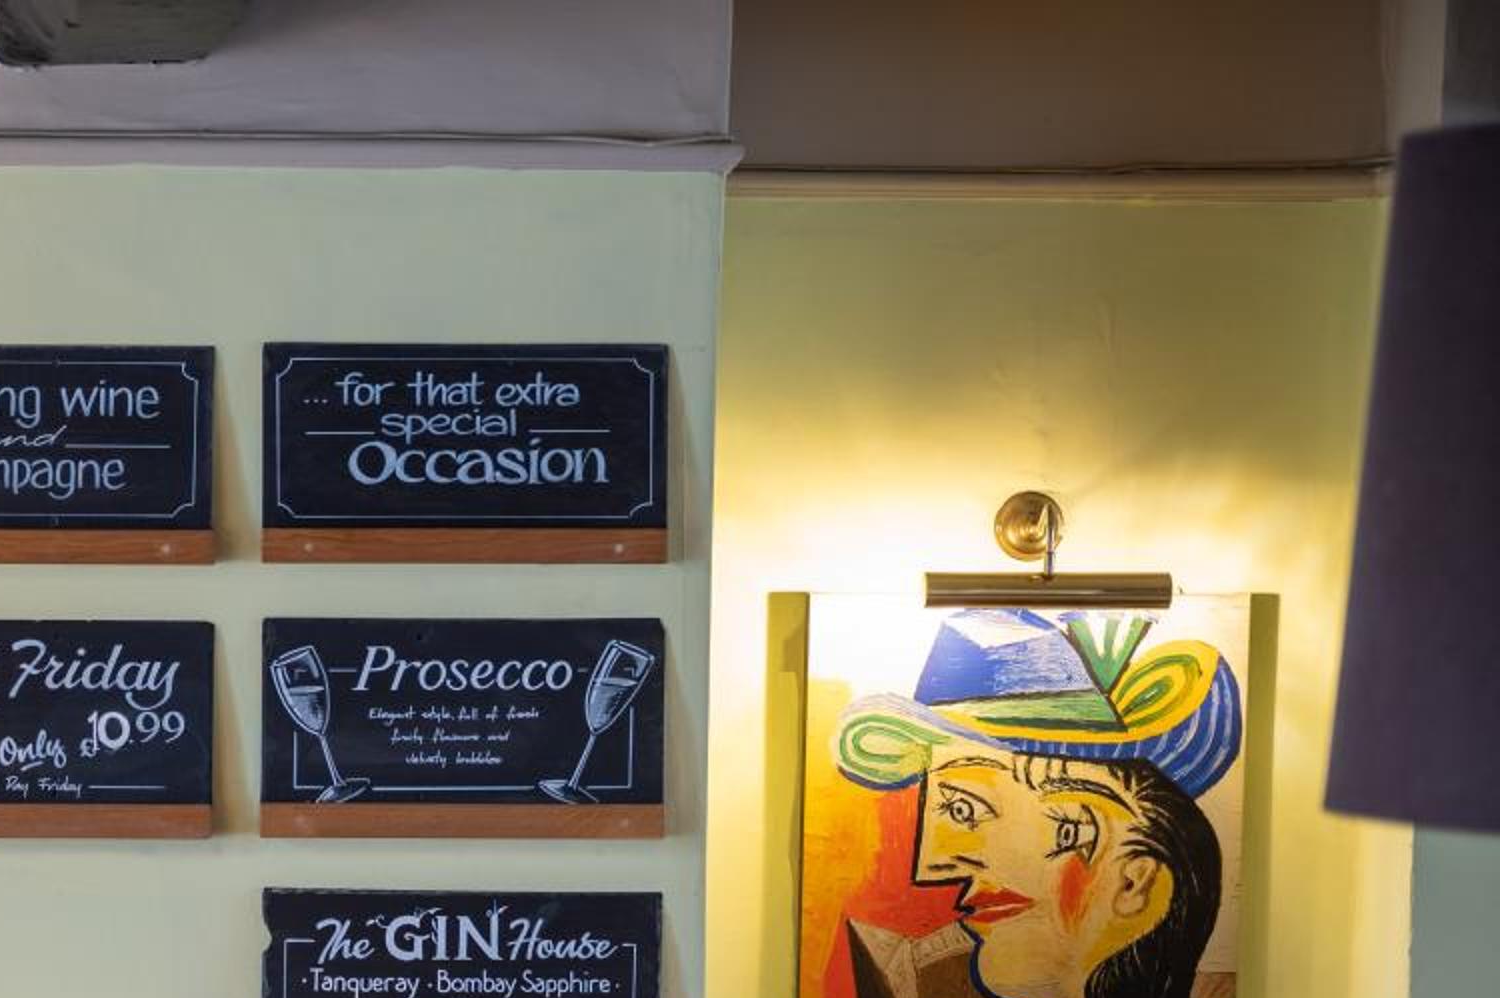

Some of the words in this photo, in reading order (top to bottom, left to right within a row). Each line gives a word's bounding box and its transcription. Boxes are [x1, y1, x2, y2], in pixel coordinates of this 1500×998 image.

[61, 379, 160, 418] wine
[408, 371, 484, 406] that
[495, 371, 580, 406] extra
[381, 408, 516, 444] special
[348, 437, 609, 486] Occasion
[8, 639, 180, 710] Friday
[351, 644, 574, 692] Prosecco
[80, 710, 185, 757] £10.99
[368, 706, 417, 726] Elegant
[5, 776, 30, 798] Day
[38, 776, 83, 798] Friday
[315, 917, 375, 965] The
[383, 906, 507, 961] GIN
[507, 917, 617, 961] House
[436, 970, 517, 998] Bombay
[520, 970, 612, 998] Sapphire
